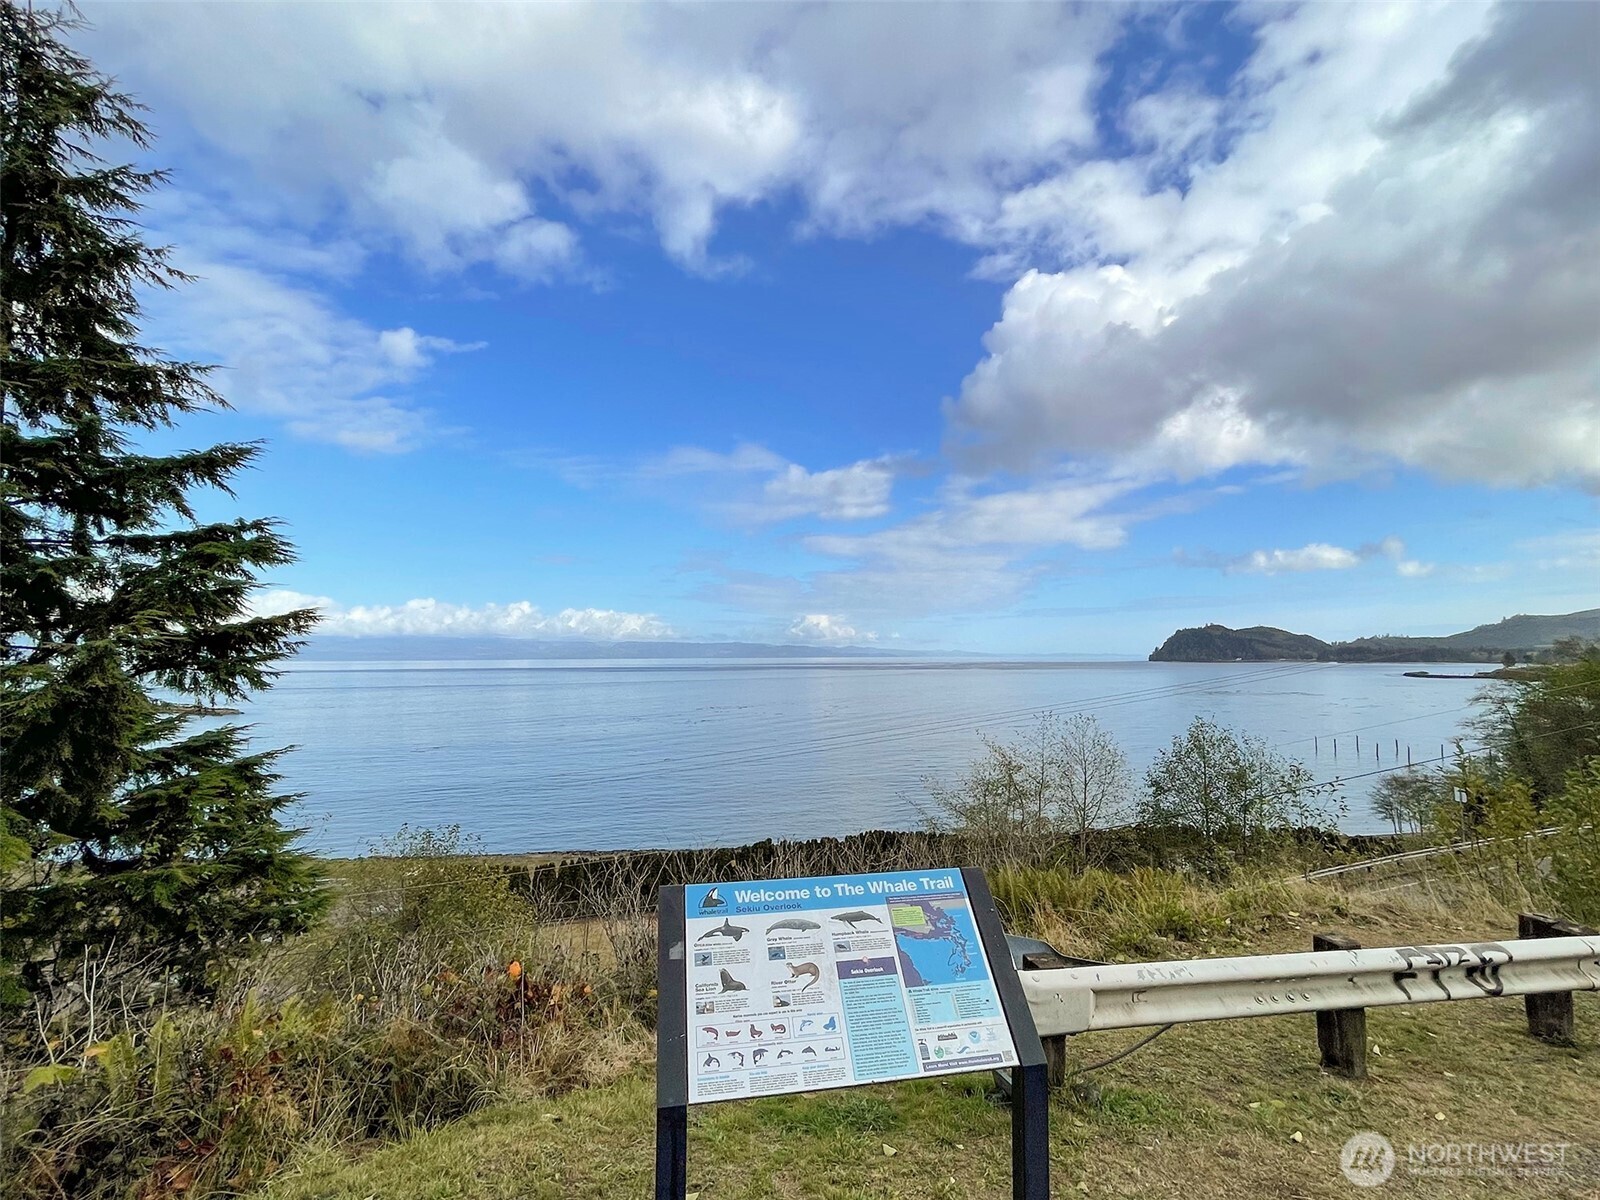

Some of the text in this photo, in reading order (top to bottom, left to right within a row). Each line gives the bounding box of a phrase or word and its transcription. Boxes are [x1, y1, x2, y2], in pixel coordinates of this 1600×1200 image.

[734, 876, 954, 903] Welcome to The Whale Trail
[735, 901, 802, 914] Sekiu Overlook
